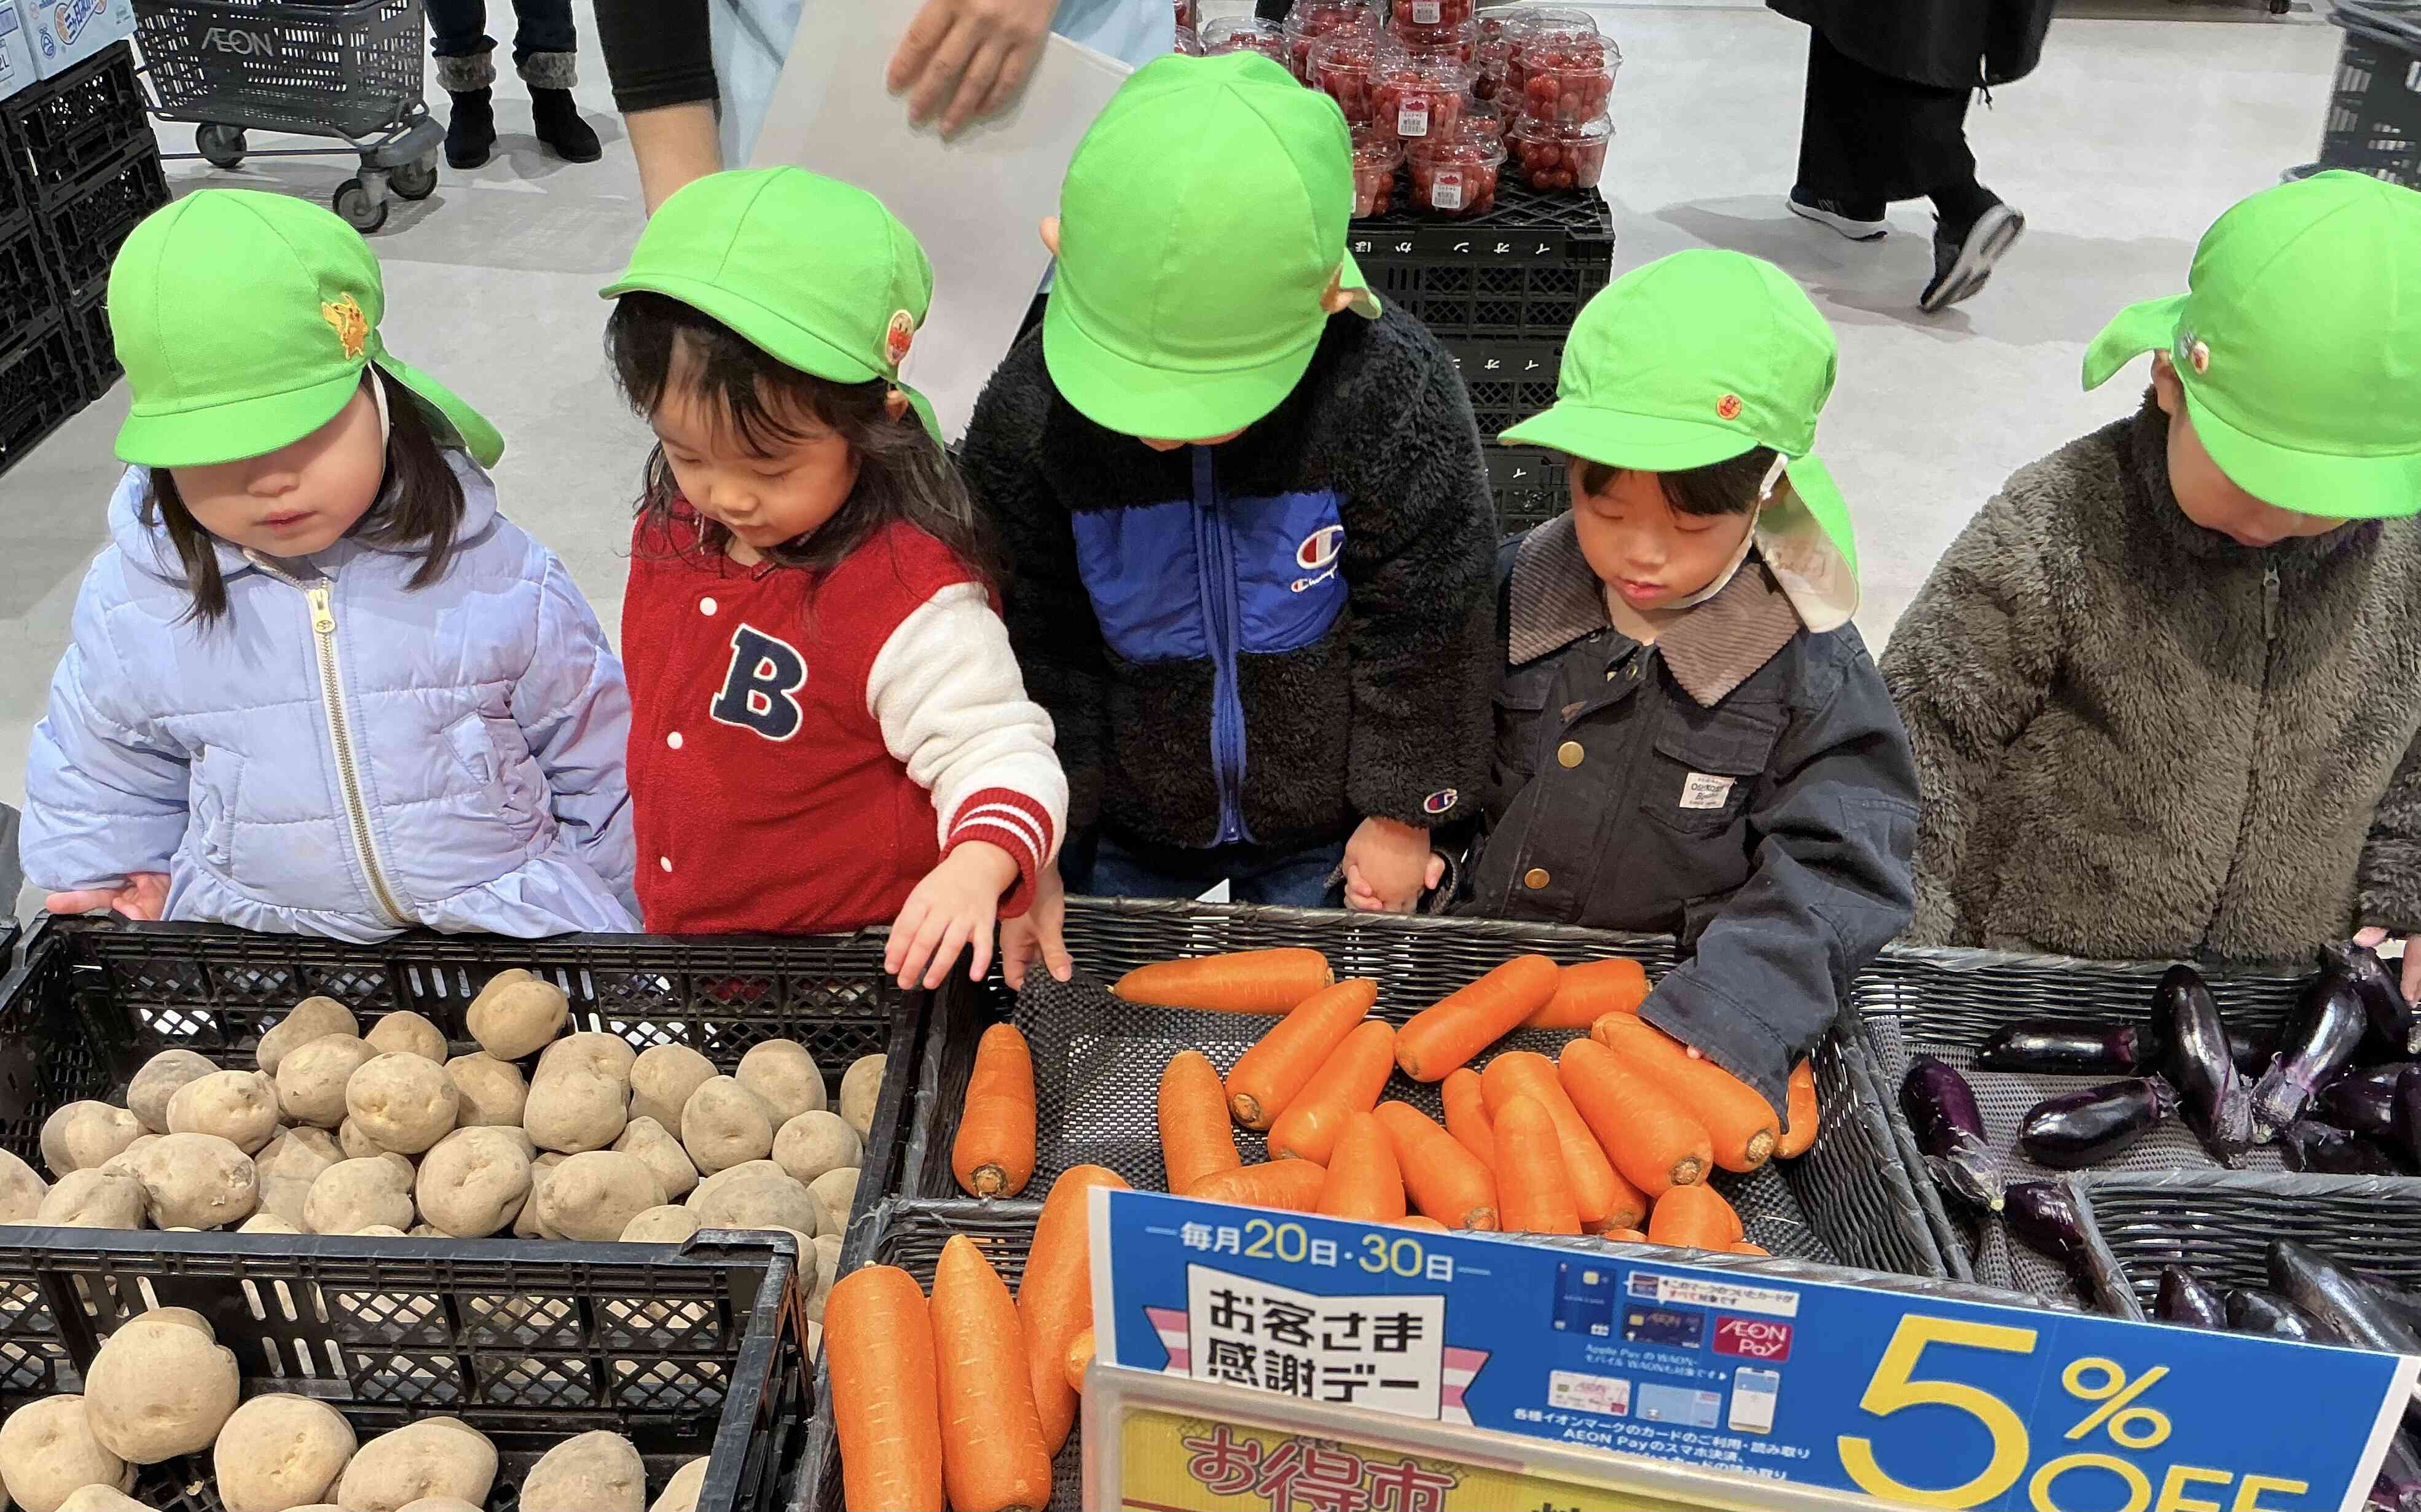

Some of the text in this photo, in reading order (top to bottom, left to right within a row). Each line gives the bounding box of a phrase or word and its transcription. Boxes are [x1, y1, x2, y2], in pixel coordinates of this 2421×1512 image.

[1452, 242, 1550, 254] イオン
[710, 622, 809, 742] B
[1209, 1289, 1423, 1353] お客さま
[1737, 1339, 1783, 1357] Pay
[1207, 1338, 1419, 1403] 感謝デー
[1563, 1428, 1613, 1444] AEON
